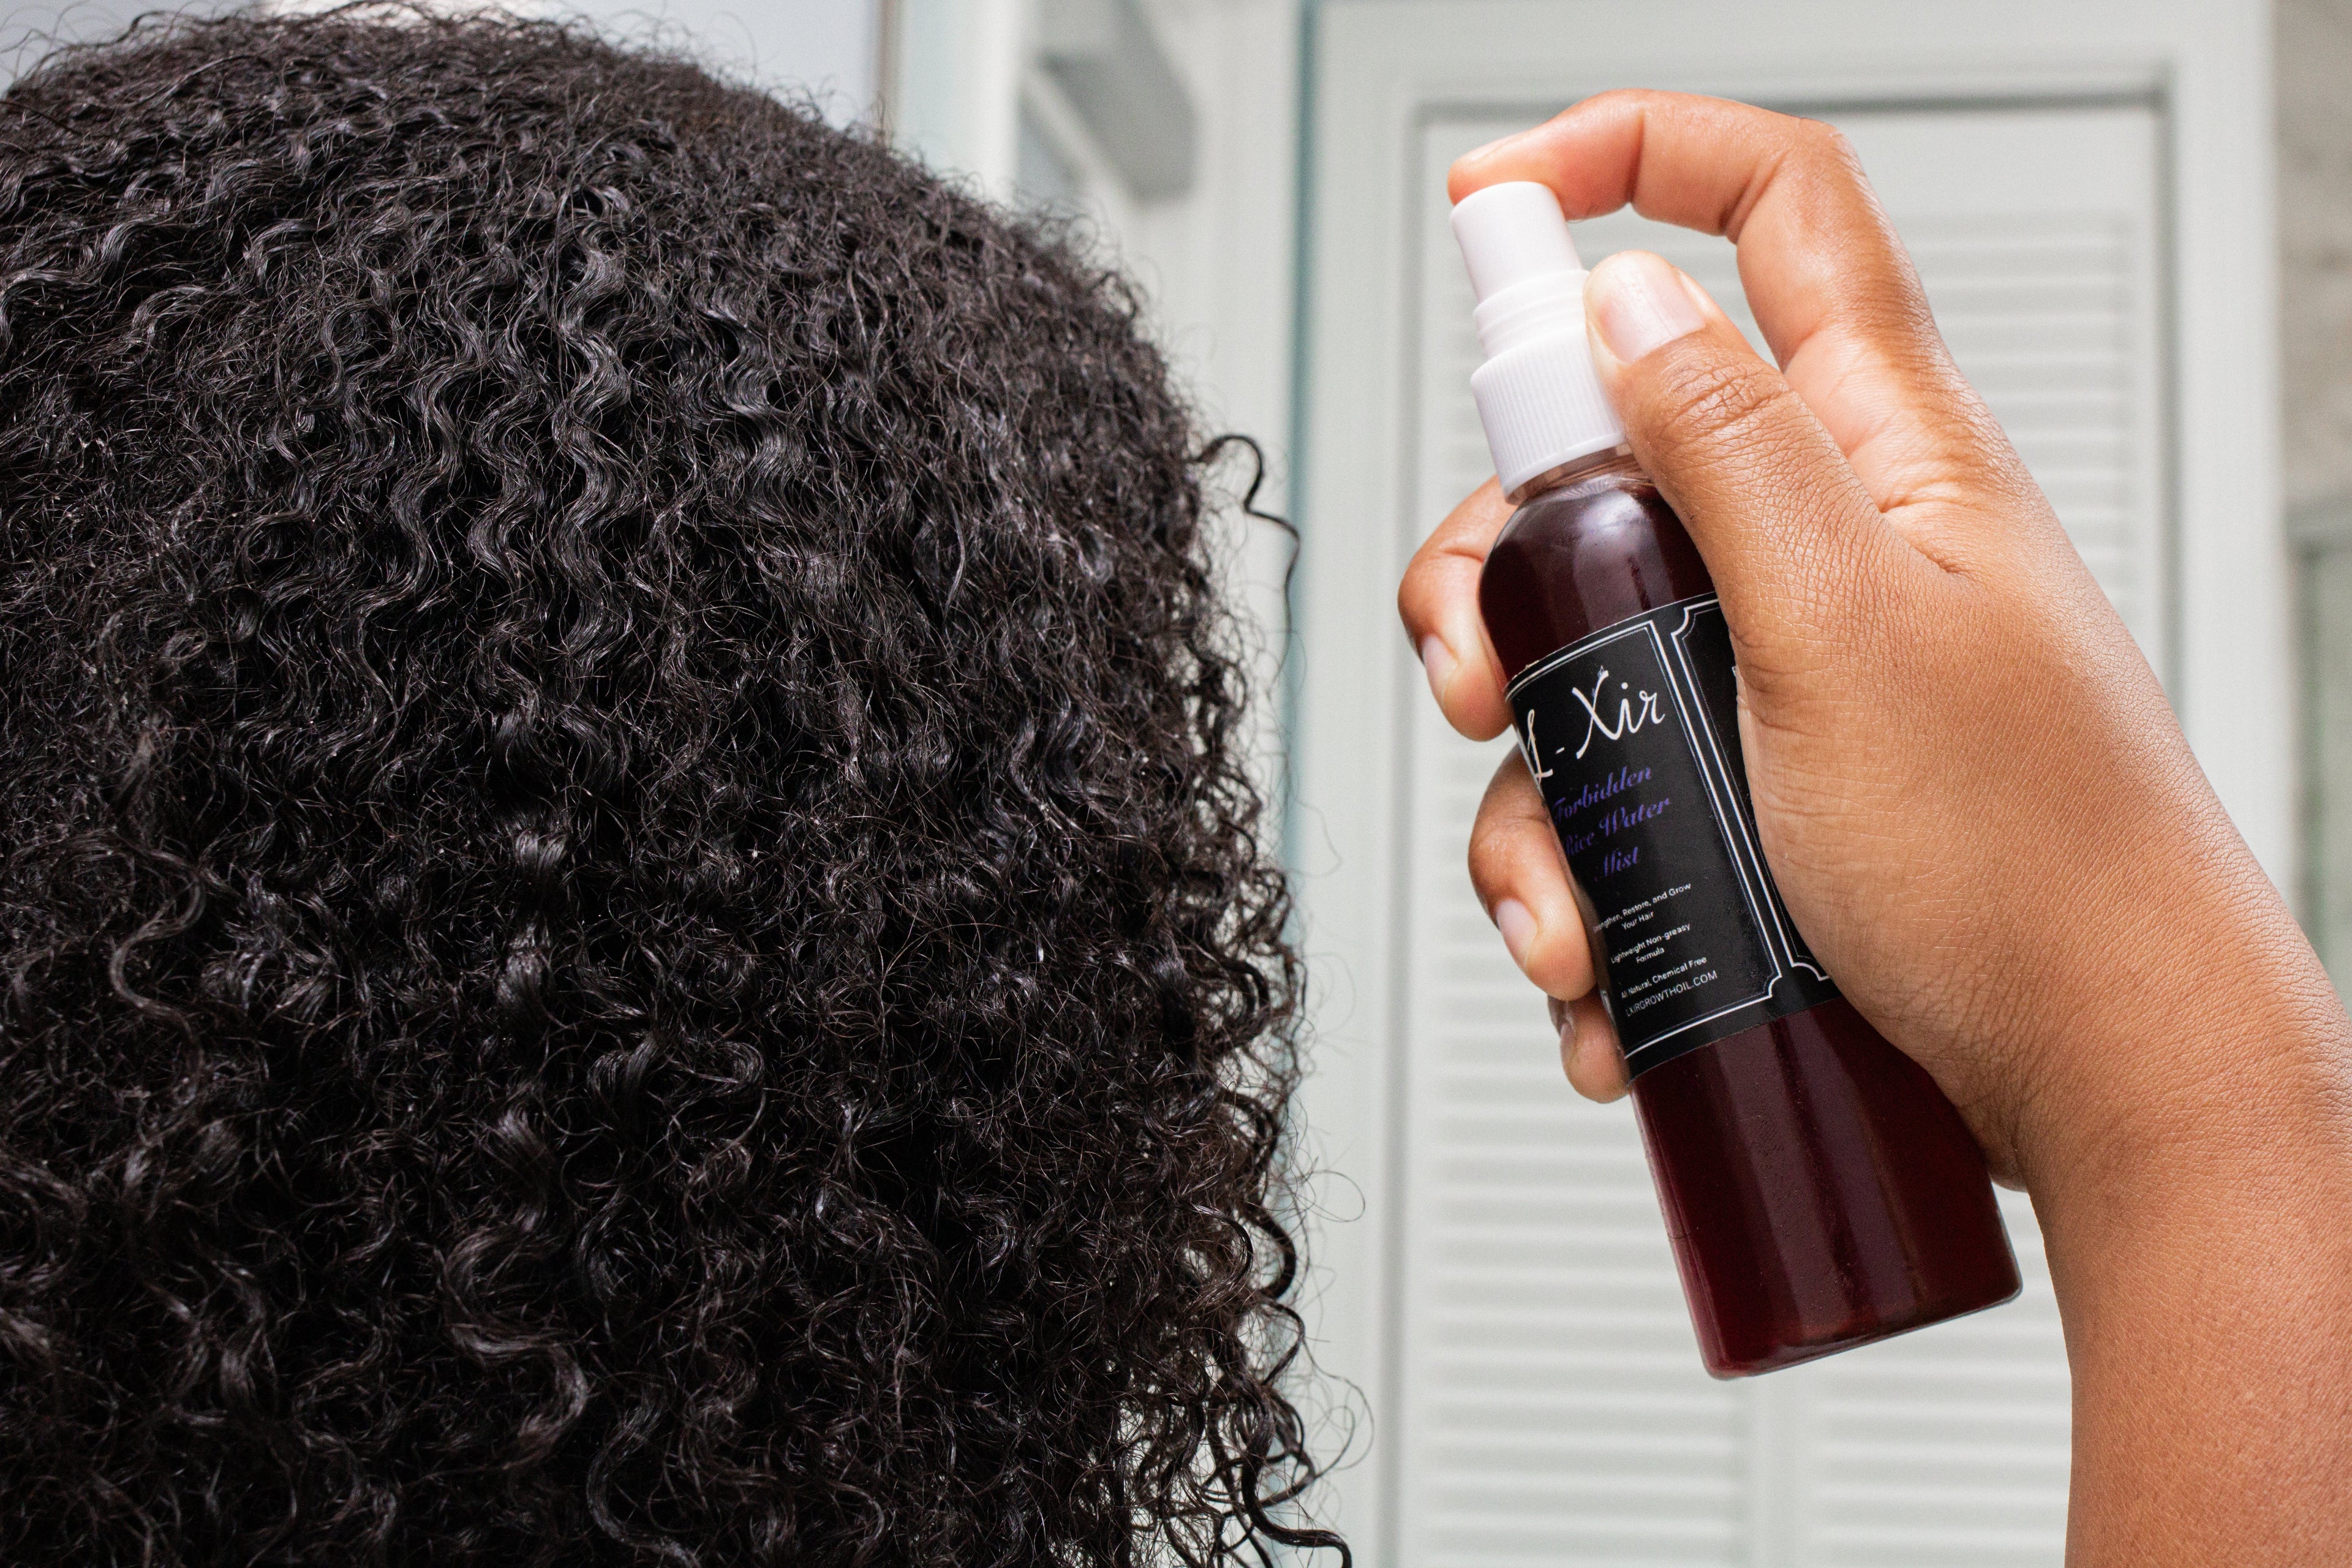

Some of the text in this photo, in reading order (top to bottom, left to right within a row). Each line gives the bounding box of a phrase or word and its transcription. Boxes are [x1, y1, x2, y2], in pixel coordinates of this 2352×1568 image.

[1599, 797, 1670, 837] Water
[1594, 846, 1638, 882] Mist
[1622, 900, 1652, 917] Restore,
[1652, 891, 1668, 903] and
[1668, 883, 1692, 896] Grow
[1621, 911, 1654, 930] Your Hair
[1610, 922, 1691, 964] Lightweight Non-greasy
[1635, 946, 1665, 964] Formula
[1625, 970, 1718, 1017] LXIRGROWTHOIL.COM
[1628, 979, 1653, 996] Natural,
[1652, 962, 1689, 984] Chemical
[1688, 956, 1708, 968] Free
